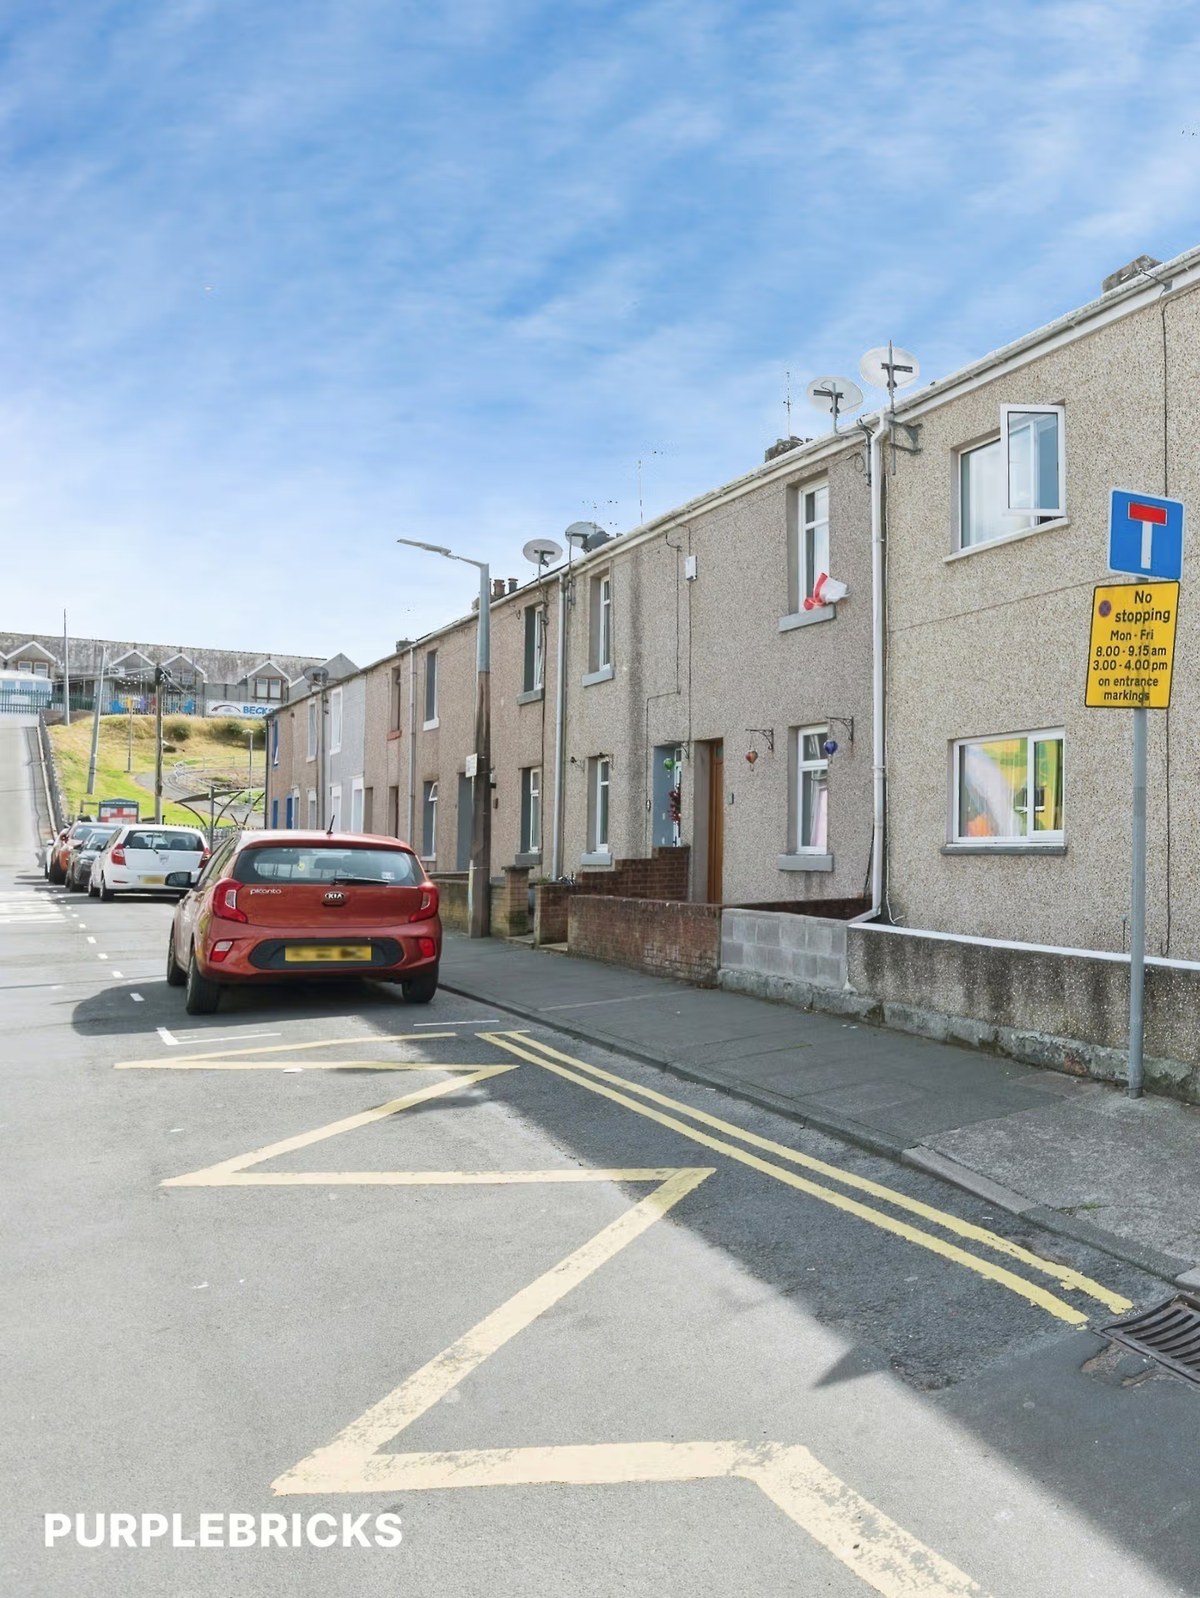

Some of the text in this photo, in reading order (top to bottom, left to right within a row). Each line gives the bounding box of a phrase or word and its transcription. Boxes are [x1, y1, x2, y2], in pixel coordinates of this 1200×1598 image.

[1134, 590, 1152, 604] No
[1114, 608, 1170, 624] stopping
[1110, 630, 1132, 641] Mon
[1140, 629, 1154, 640] Fri
[1096, 646, 1120, 657] 8.00
[1128, 645, 1150, 657] 9.15
[1151, 647, 1167, 656] am
[1093, 660, 1117, 671] 3.00
[1124, 660, 1150, 671] 4.00
[1151, 661, 1168, 672] pm
[1098, 676, 1159, 687] on entrance
[1103, 690, 1150, 703] markings
